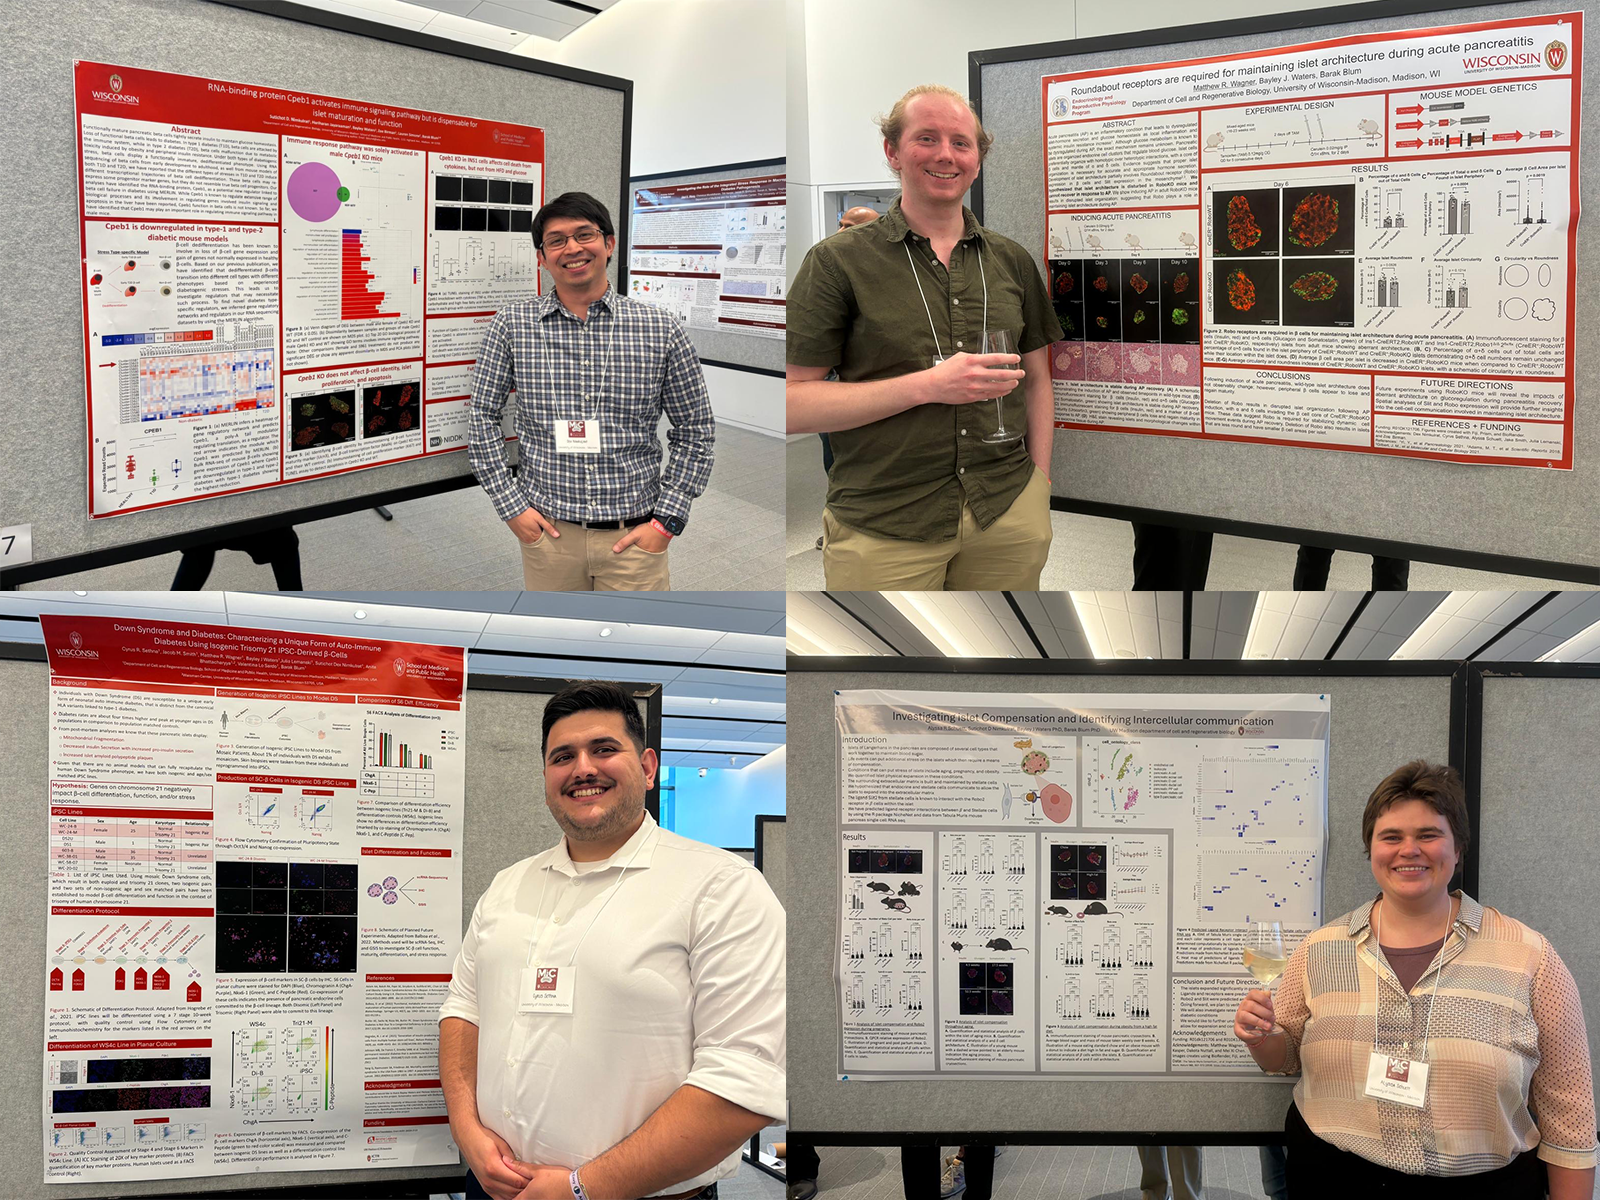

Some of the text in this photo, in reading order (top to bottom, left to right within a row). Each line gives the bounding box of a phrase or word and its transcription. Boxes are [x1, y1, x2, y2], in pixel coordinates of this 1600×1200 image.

[1071, 38, 1533, 95] Roundabout receptors are required for maintaining islet architecture during acute pancreatitis
[1462, 53, 1540, 68] WISCONSIN
[1230, 79, 1255, 87] Wagner,
[1258, 76, 1281, 84] Bayley
[1319, 69, 1341, 78] Barak
[1132, 98, 1166, 107] Department
[1174, 95, 1187, 103] Cell
[1201, 91, 1244, 99] Regenerative
[1273, 84, 1307, 93] University
[1317, 77, 1389, 88] Wisconsin-Madison,
[1392, 73, 1427, 81] Madison,
[1429, 69, 1441, 77] WI
[1420, 83, 1537, 99] MOUSE MODEL GENETICS
[91, 91, 139, 102] WISCONSIN
[207, 83, 258, 97] RNA-binding
[259, 91, 286, 100] protein
[287, 94, 309, 104] Cpeb1
[311, 99, 341, 108] activates
[341, 104, 368, 112] immune
[369, 107, 395, 117] signaling
[396, 111, 420, 120] pathway
[437, 117, 469, 126] dispensable
[1245, 101, 1334, 115] EXPERIMENTAL DESIGN
[328, 112, 363, 122] maturation
[377, 119, 402, 127] function
[1101, 118, 1136, 128] ABSTRACT
[171, 126, 200, 134] Abstract
[1351, 164, 1388, 172] RESULTS
[1101, 212, 1123, 220] ACUTE
[1124, 211, 1171, 219] PANCREATITIS
[105, 222, 129, 230] Cpeb1
[1256, 371, 1310, 380] CONCLUSIONS
[1420, 379, 1513, 390] FUTURE DIRECTIONS
[1411, 419, 1470, 429] REFERENCES
[1480, 423, 1521, 431] FUNDING
[2, 536, 15, 555] 7
[113, 623, 136, 631] Down
[136, 625, 174, 635] Syndrome
[190, 629, 225, 639] Diabetes:
[227, 633, 277, 644] Characterizing
[284, 638, 309, 646] Unique
[309, 639, 327, 647] Form
[336, 642, 381, 651] Auto-Immune
[55, 648, 99, 657] WISCONSIN
[153, 637, 186, 646] Diabetes
[187, 640, 208, 649] Using
[240, 644, 267, 652] Trisomy
[278, 647, 322, 656] IPSC-Derived
[323, 650, 347, 658] β-Cells
[52, 679, 87, 687] Background
[893, 712, 1274, 728] Investigating islet Compensation and Identifying Intercellular communication
